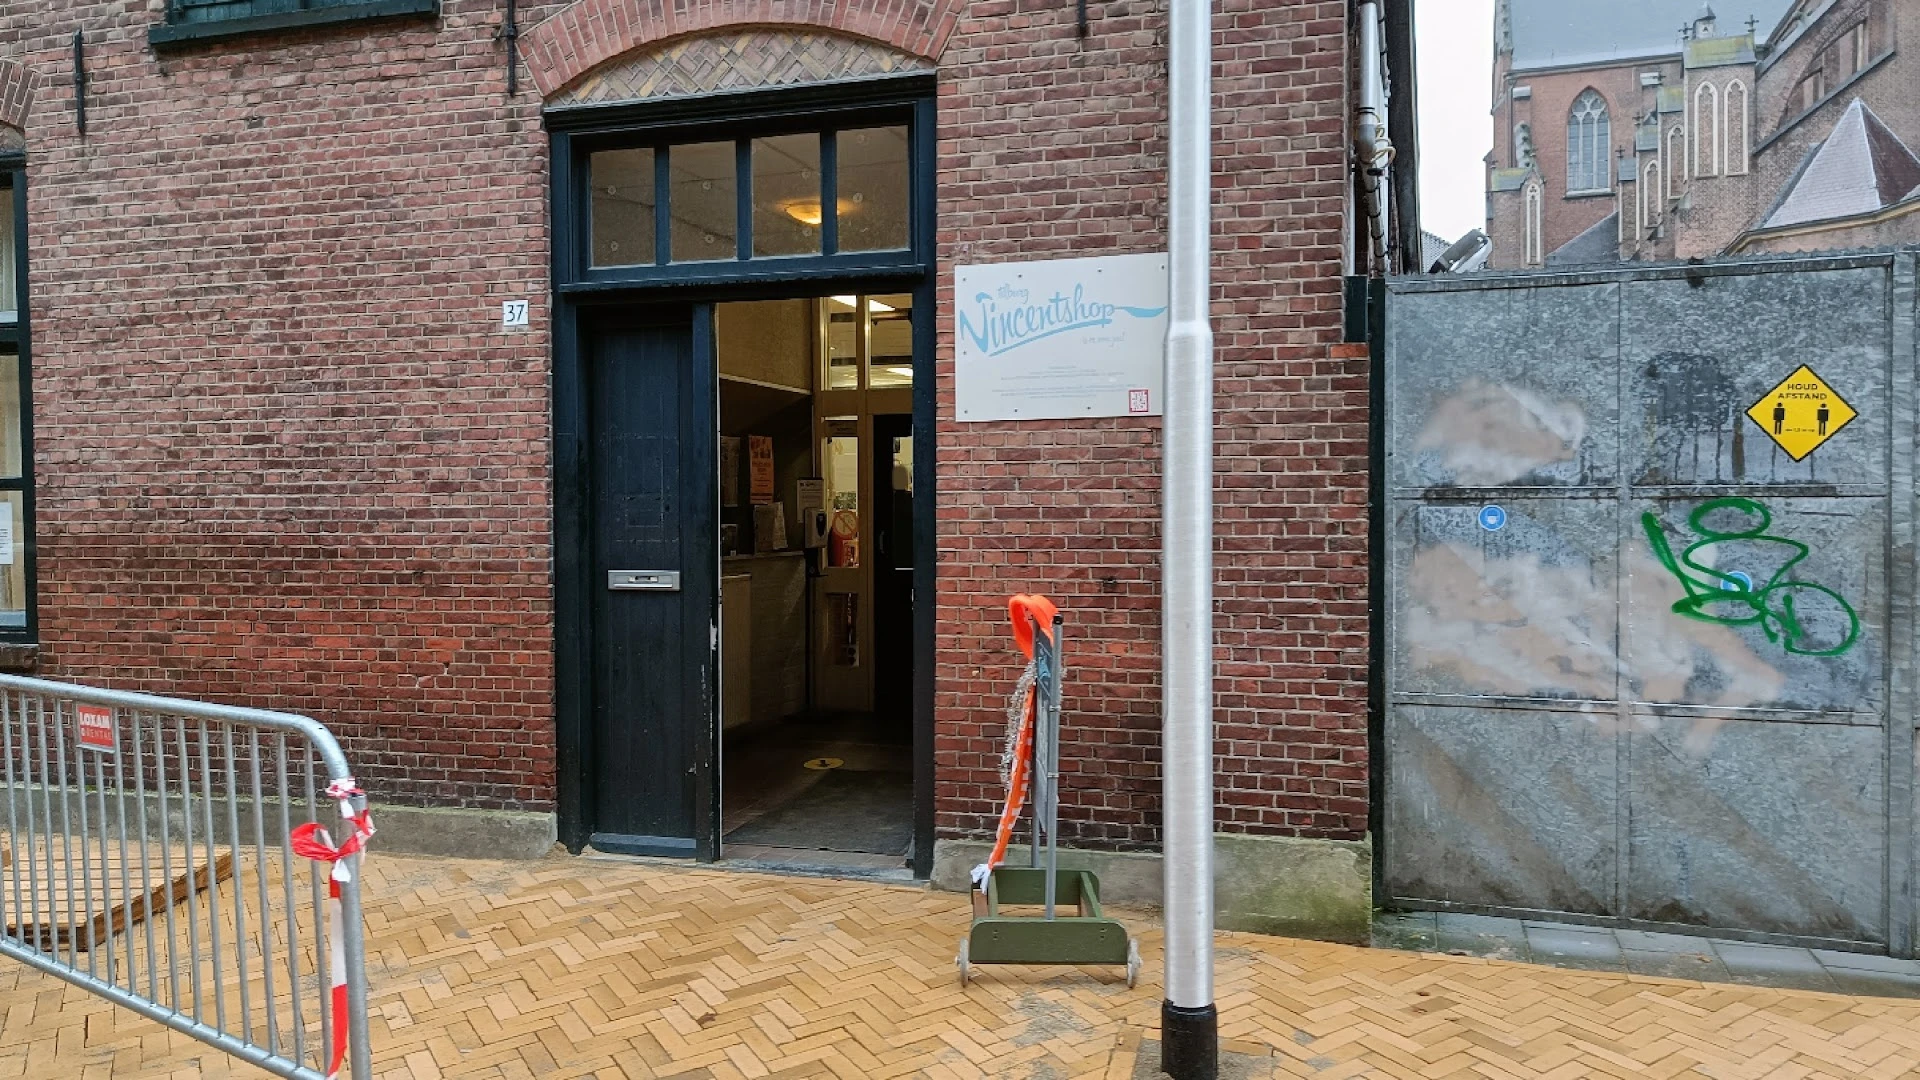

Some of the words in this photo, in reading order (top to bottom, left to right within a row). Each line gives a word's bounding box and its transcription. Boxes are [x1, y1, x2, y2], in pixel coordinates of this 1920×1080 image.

[506, 304, 525, 322] 37
[959, 283, 1116, 354] Vincentshop
[79, 711, 110, 728] LOXAM
